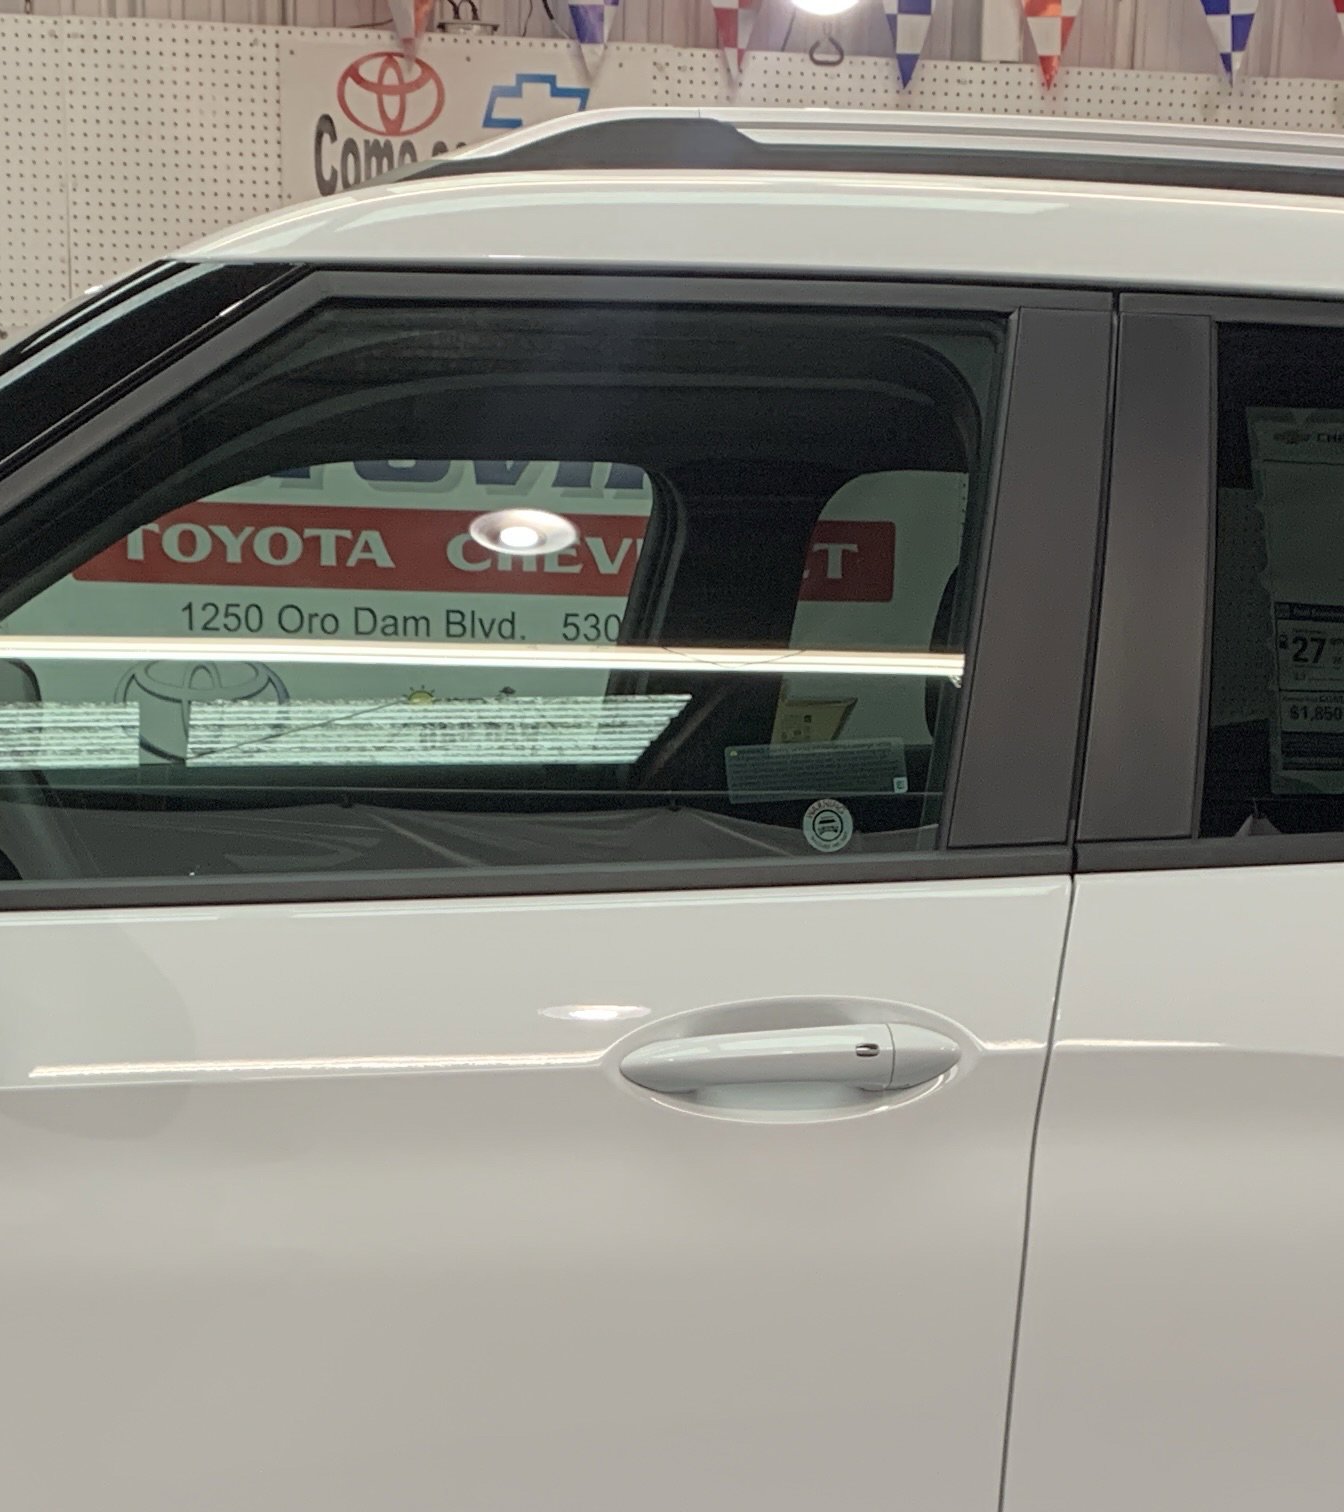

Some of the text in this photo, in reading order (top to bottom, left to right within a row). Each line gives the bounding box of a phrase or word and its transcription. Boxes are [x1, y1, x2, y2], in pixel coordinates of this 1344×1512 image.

[127, 522, 396, 569] TOYOTA
[181, 601, 264, 632] 1250
[277, 604, 340, 635] Oro
[353, 606, 431, 638] Dam
[445, 609, 526, 641] Blvd.
[1291, 635, 1326, 664] 27
[1289, 704, 1343, 722] $1,850
